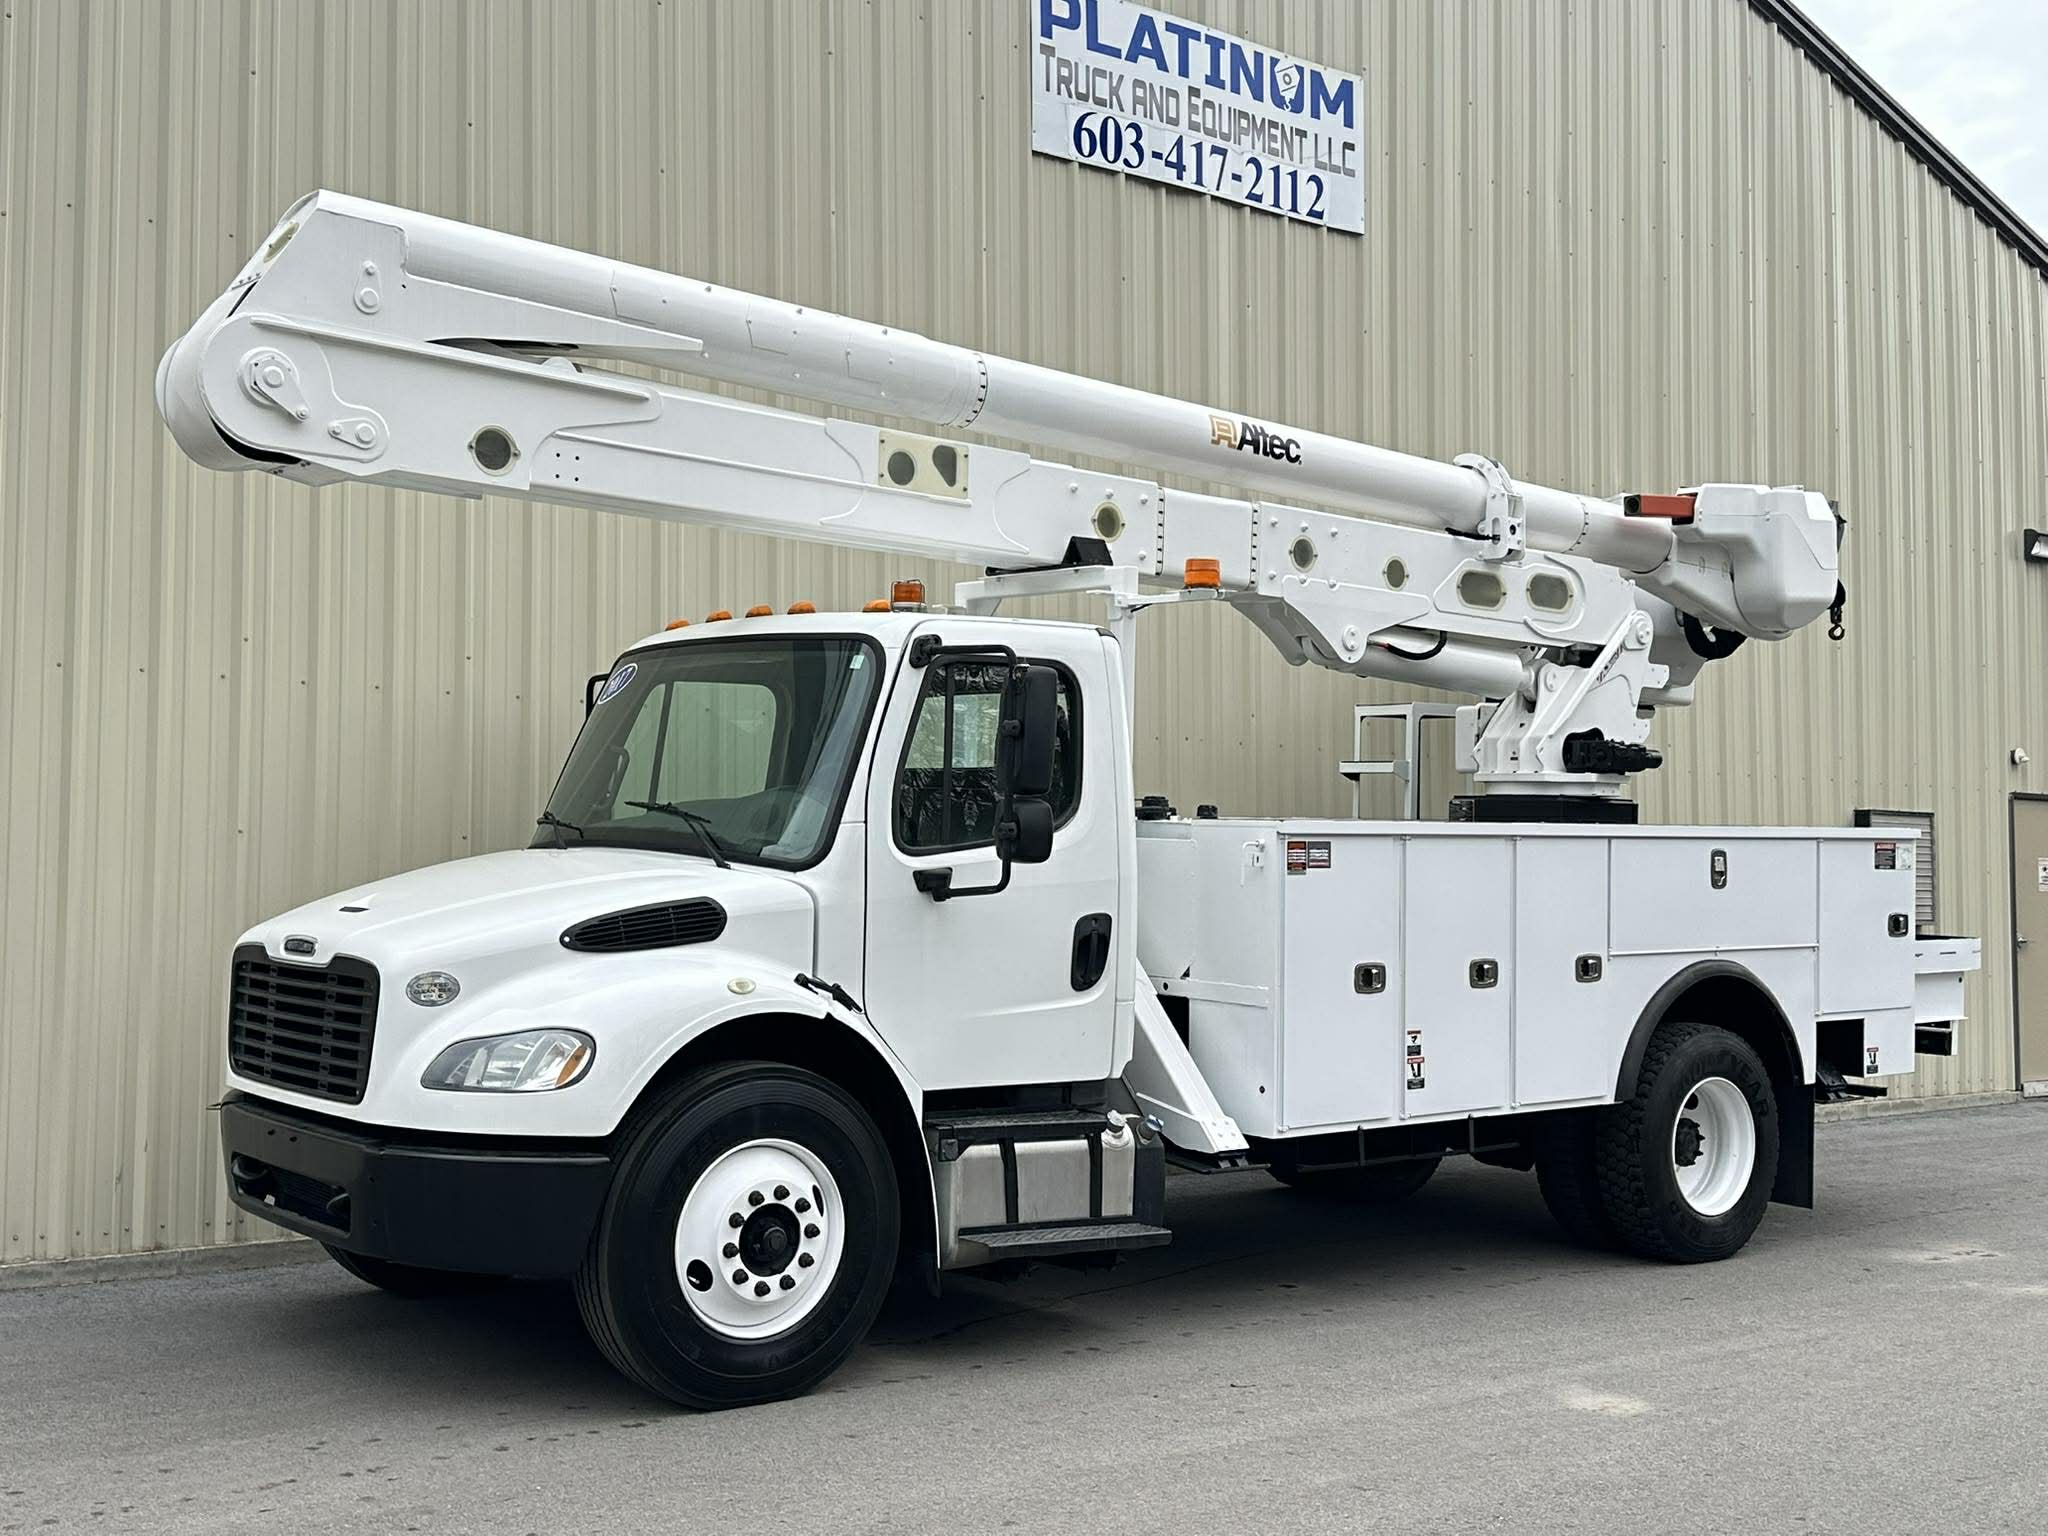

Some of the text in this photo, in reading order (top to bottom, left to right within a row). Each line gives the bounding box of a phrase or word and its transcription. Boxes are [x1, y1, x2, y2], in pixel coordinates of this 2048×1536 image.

[1040, 0, 1355, 129] PLATINUM
[1073, 111, 1326, 220] 603-417-2112
[1132, 78, 1180, 127] AND
[1188, 85, 1308, 164] EQUIPMENT
[1314, 133, 1356, 178] LLC
[1237, 421, 1301, 464] Altec
